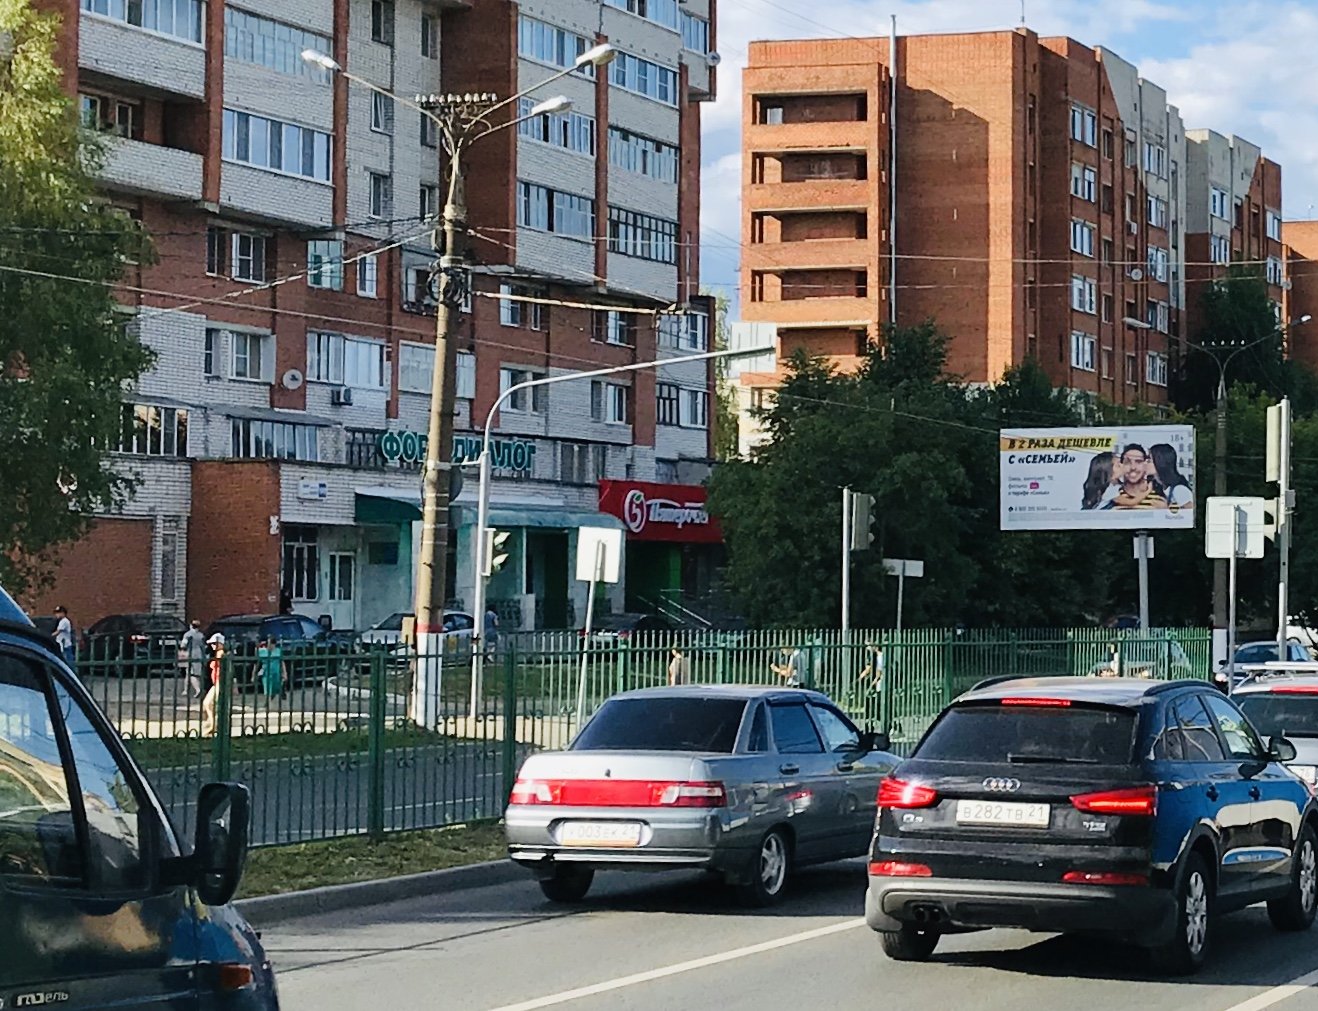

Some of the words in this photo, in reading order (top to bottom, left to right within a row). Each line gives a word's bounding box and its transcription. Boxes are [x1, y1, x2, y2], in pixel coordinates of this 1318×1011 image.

[1008, 439, 1016, 449] В
[1018, 440, 1026, 449] 2
[1027, 438, 1055, 449] РАЗА
[1057, 437, 1112, 449] ДЕШЕВЛЕ
[1008, 454, 1016, 464] С
